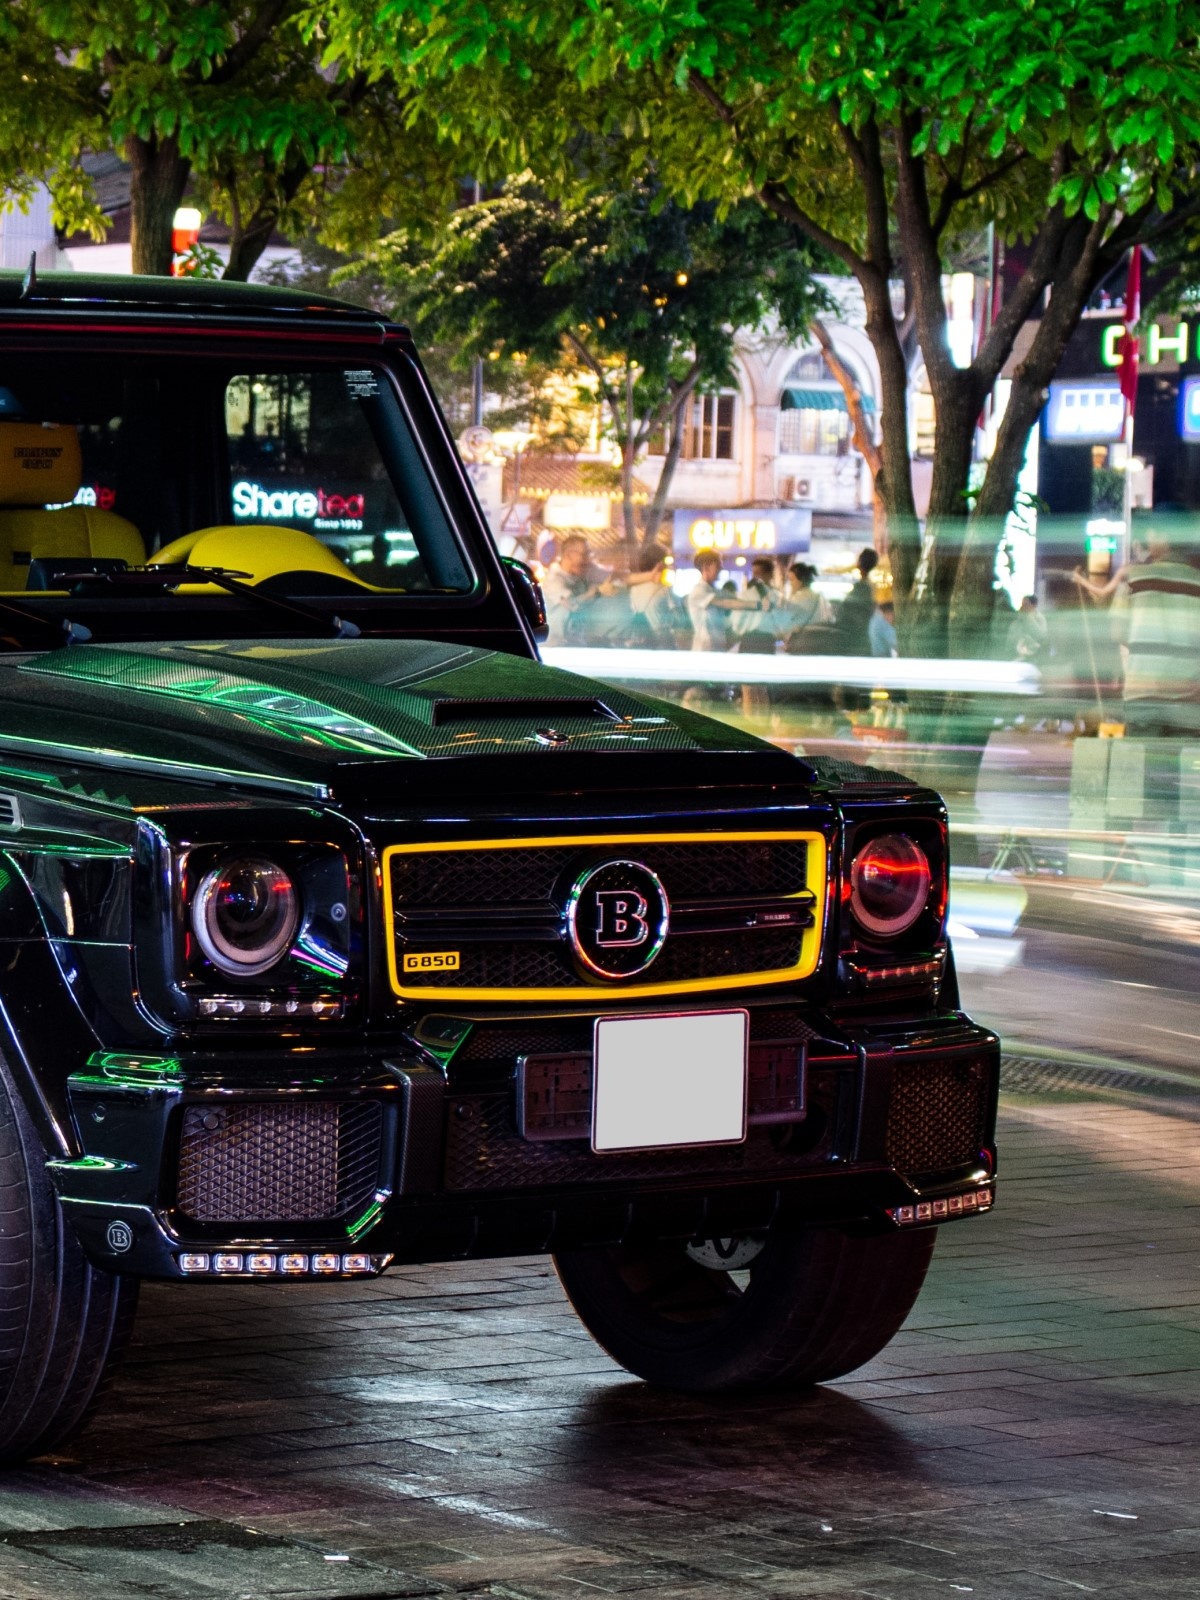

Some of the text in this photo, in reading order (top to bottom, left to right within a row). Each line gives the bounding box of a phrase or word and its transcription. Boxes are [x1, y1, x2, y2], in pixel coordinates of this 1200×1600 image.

[1102, 321, 1200, 366] CH
[232, 481, 365, 518] Sharetea
[596, 891, 648, 947] B
[111, 1228, 128, 1247] B
